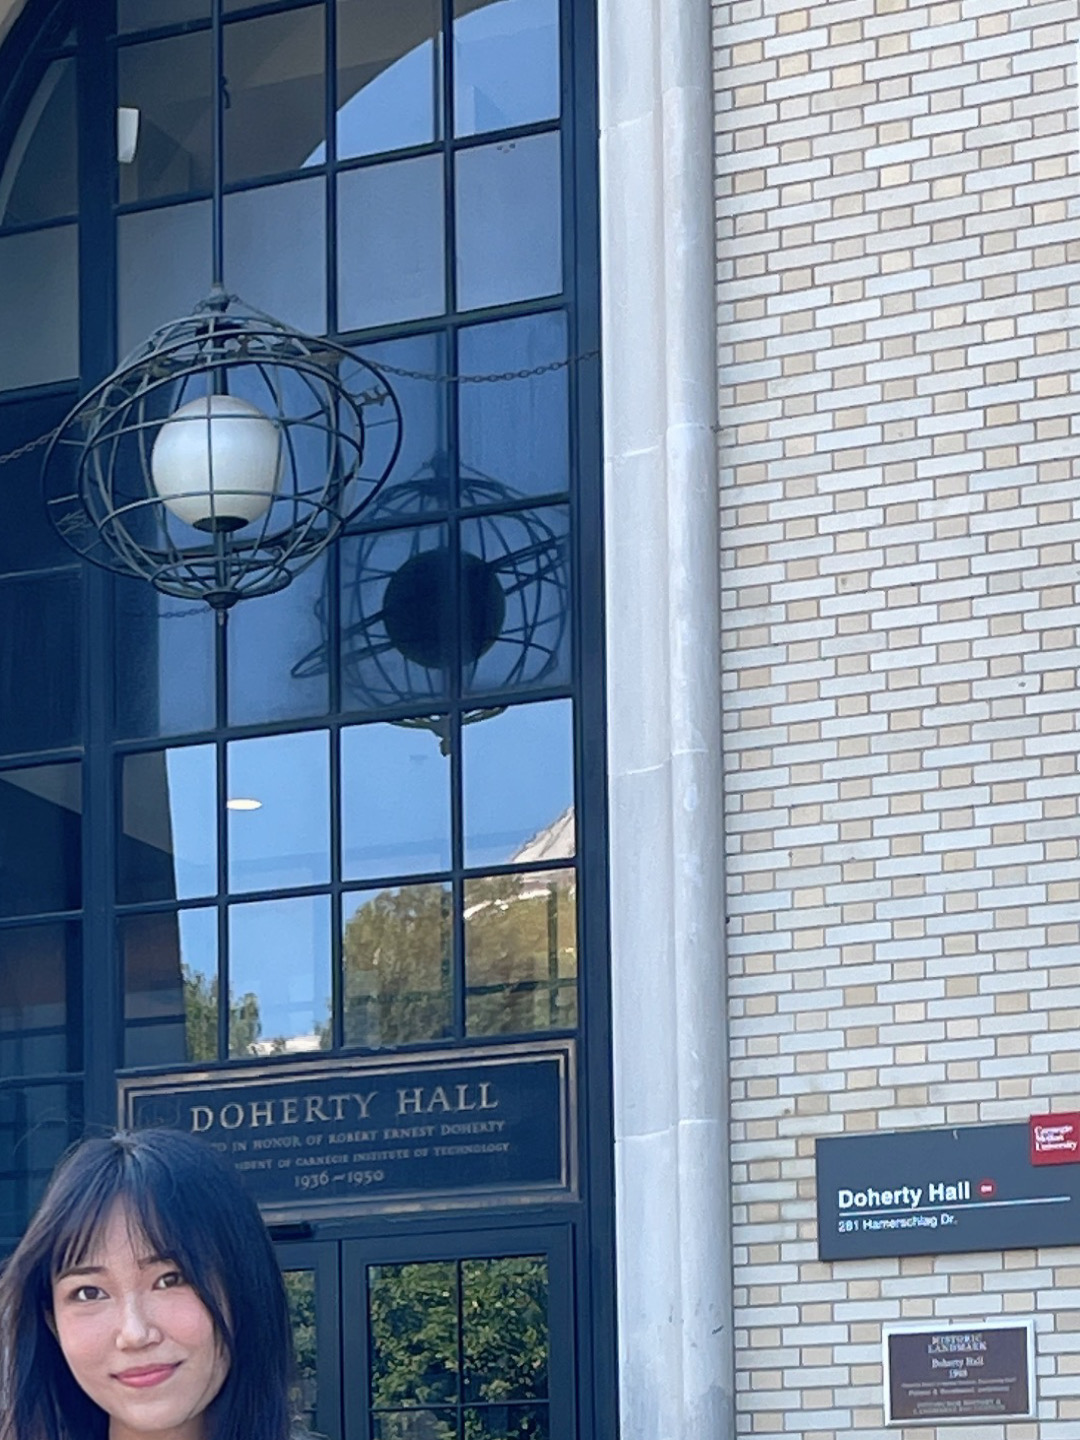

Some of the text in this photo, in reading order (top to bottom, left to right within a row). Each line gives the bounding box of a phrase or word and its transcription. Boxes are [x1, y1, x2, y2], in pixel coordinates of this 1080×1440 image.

[190, 1082, 499, 1133] DOHERTY HALL
[231, 1141, 247, 1153] IN
[253, 1135, 302, 1150] HONOR
[306, 1134, 323, 1146] OF
[329, 1129, 378, 1145] ROBERT
[383, 1125, 435, 1140] ERNEST
[441, 1120, 505, 1136] DOHERTY
[278, 1158, 291, 1169] OF
[414, 1146, 429, 1158] OF
[838, 1180, 970, 1209] Doherty Hall
[940, 1213, 959, 1225] Dr.
